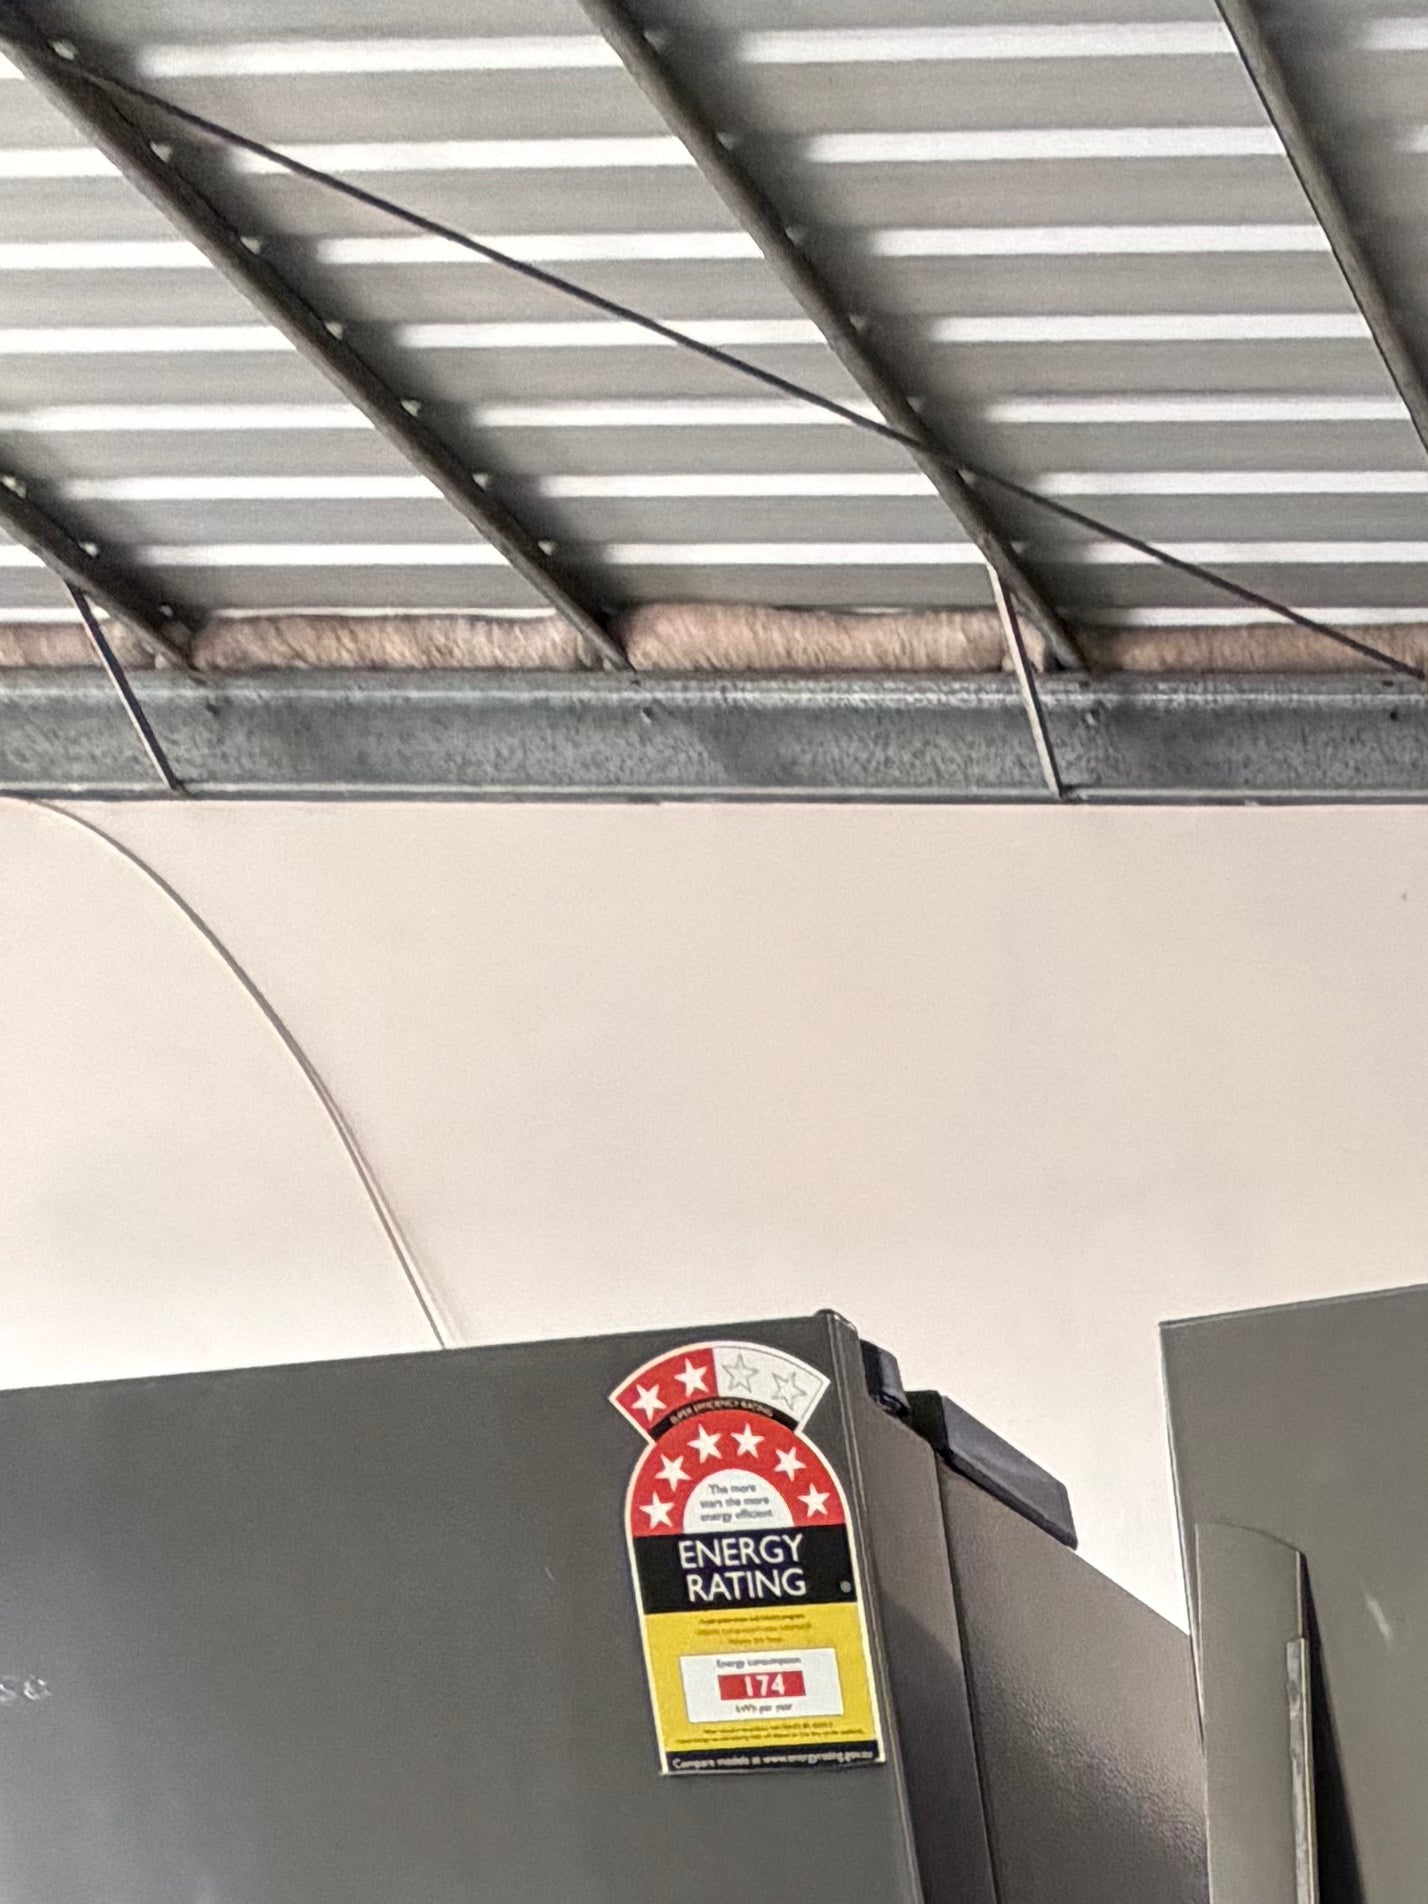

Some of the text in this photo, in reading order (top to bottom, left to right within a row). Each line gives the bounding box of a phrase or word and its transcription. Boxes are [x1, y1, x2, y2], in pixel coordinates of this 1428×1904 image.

[709, 1484, 756, 1495] The more
[678, 1533, 803, 1569] ENERGY
[686, 1567, 807, 1602] RATING
[744, 1672, 785, 1697] 174
